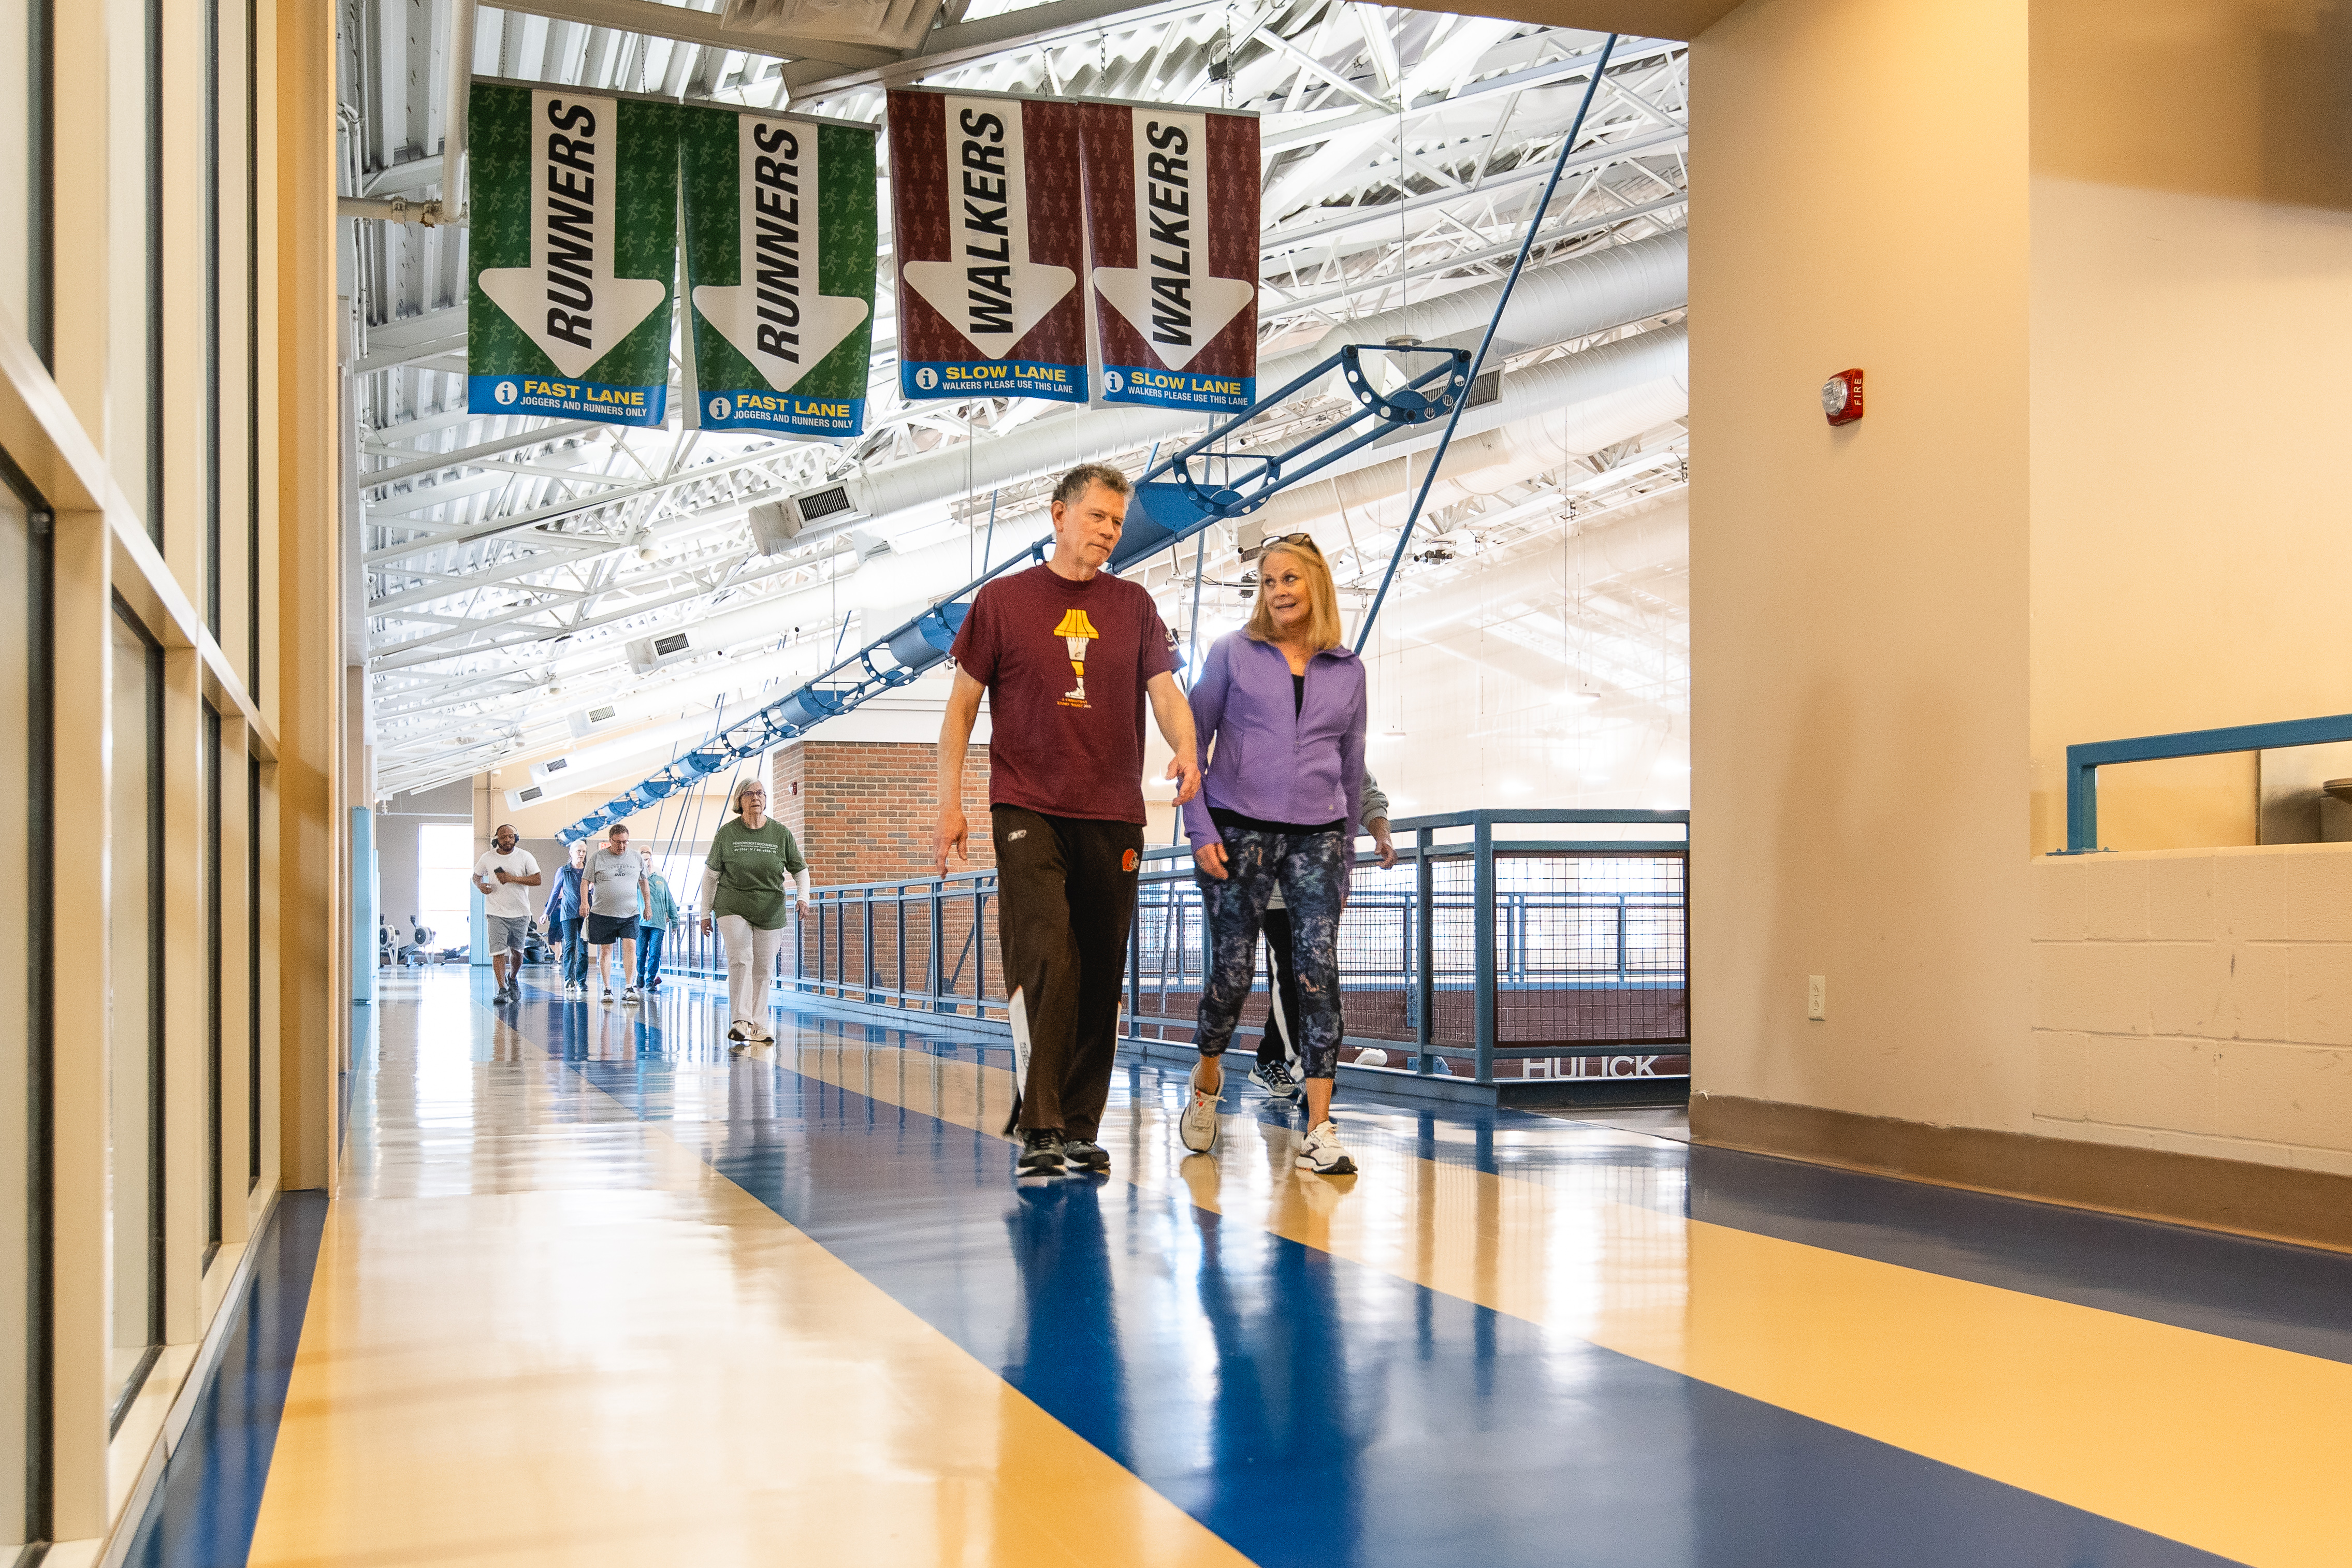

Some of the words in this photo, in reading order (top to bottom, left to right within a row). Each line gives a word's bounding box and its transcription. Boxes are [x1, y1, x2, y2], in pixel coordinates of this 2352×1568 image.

[547, 99, 596, 350] RUNNERS
[960, 108, 1013, 333] WALKERS
[753, 123, 800, 364] RUNNERS
[1146, 121, 1192, 346] WALKERS
[946, 366, 1007, 380] SLOW
[1015, 365, 1066, 382] LANE
[1131, 371, 1185, 389] SLOW
[1192, 379, 1241, 395] LANE
[524, 381, 579, 398] FAST
[587, 387, 644, 405] LANE
[942, 381, 982, 390] WALKERS
[984, 380, 1015, 389] PLEASE
[1017, 380, 1032, 389] USE
[1035, 382, 1052, 391] THIS
[1054, 384, 1073, 394] LANE
[1127, 386, 1162, 398] WALKERS
[1164, 391, 1192, 401] PLEASE
[1194, 394, 1208, 403] USE
[1210, 395, 1226, 404] THIS
[1228, 397, 1248, 405] LANE
[520, 396, 560, 409] JOGGERS
[562, 400, 580, 411] AND
[584, 403, 623, 415] RUNNERS
[626, 408, 647, 417] ONLY
[737, 395, 788, 411] FAST
[795, 401, 850, 417] LANE
[734, 410, 771, 420] JOGGERS
[773, 413, 789, 424] AND
[792, 416, 830, 428] RUNNERS
[832, 419, 853, 428] ONLY
[1522, 1055, 1659, 1080] HULICK
